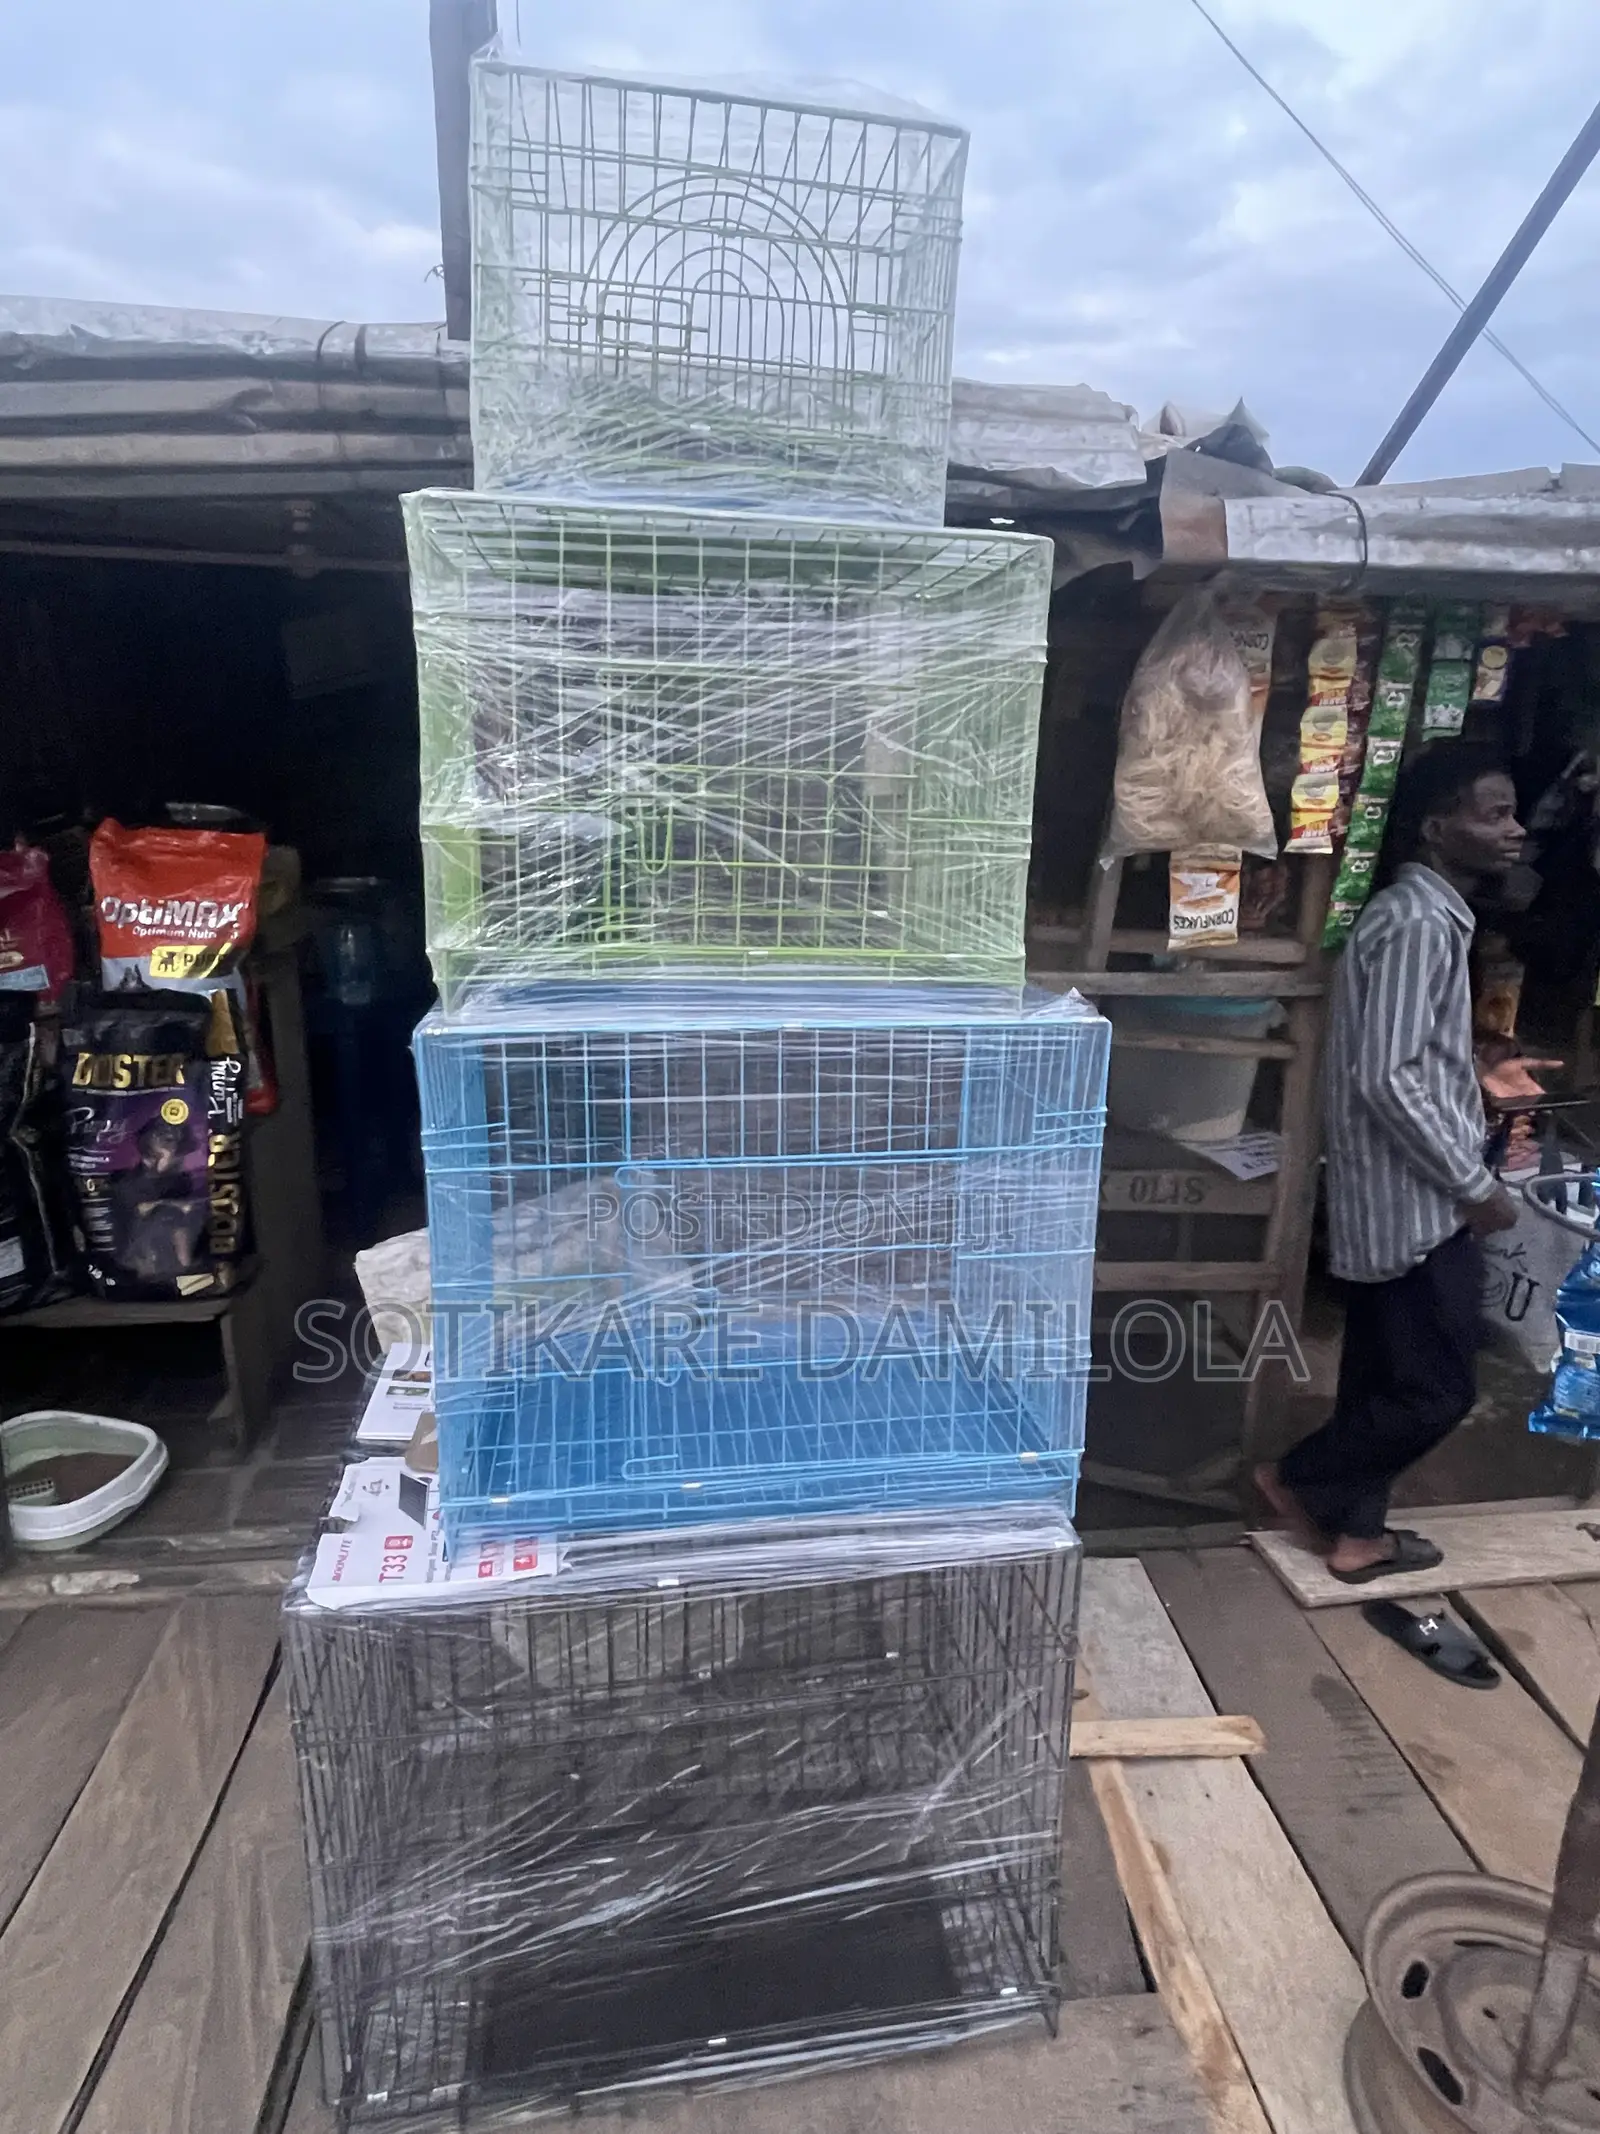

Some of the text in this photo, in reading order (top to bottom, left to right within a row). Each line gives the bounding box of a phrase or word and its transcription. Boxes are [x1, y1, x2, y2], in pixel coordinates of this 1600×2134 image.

[100, 895, 244, 929] OptiMAX
[1173, 909, 1235, 931] CORNFLAKES
[132, 925, 186, 938] Optimum
[207, 1056, 242, 1119] Puppy
[378, 1554, 408, 1584] T33
